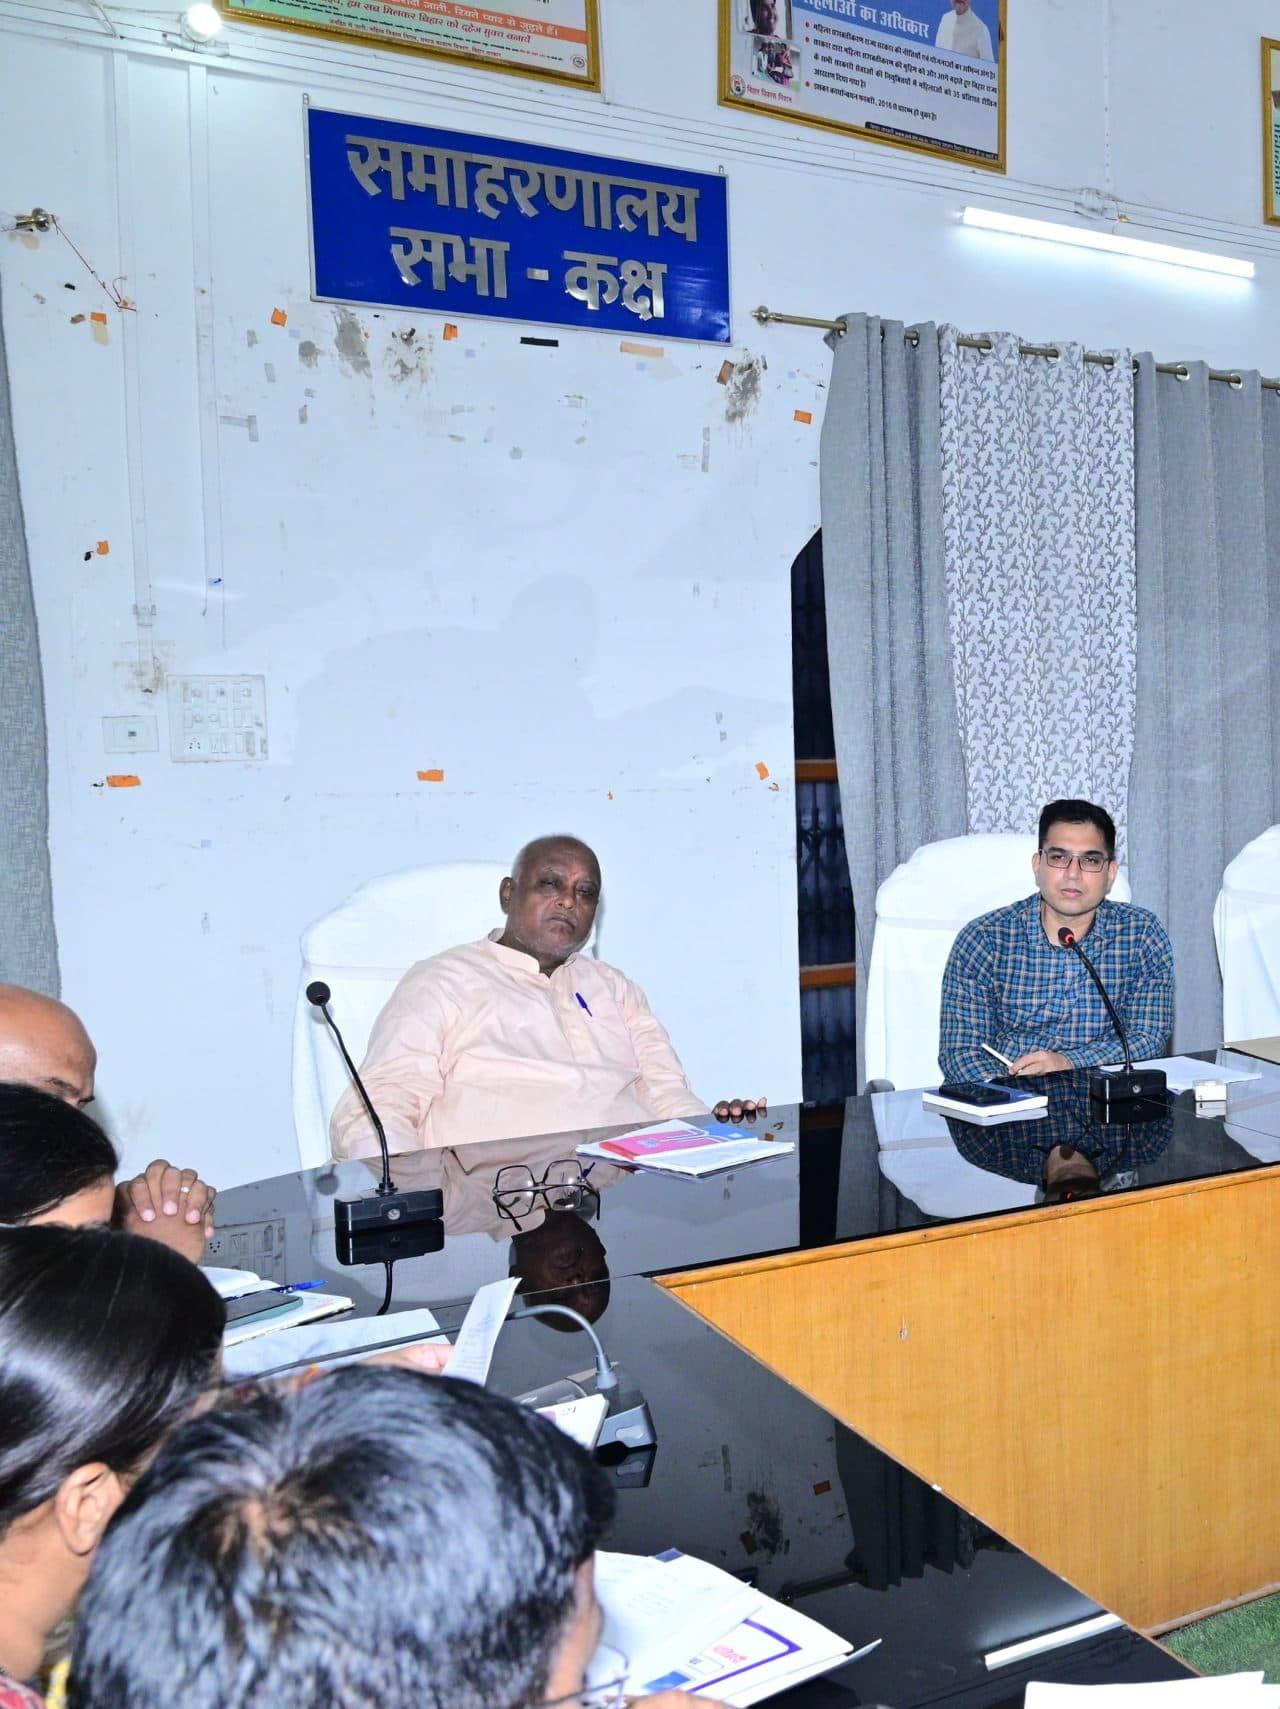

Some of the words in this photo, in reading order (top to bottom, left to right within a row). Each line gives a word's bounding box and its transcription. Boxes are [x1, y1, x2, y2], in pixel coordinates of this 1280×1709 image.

[383, 5, 416, 20] मिलकर
[418, 9, 444, 26] बिहार
[446, 19, 459, 29] को
[860, 5, 877, 24] का
[880, 10, 929, 39] अधिकार
[345, 134, 700, 242] समाहरणालय
[389, 226, 510, 299] सभा
[562, 250, 668, 321] कक्ष
